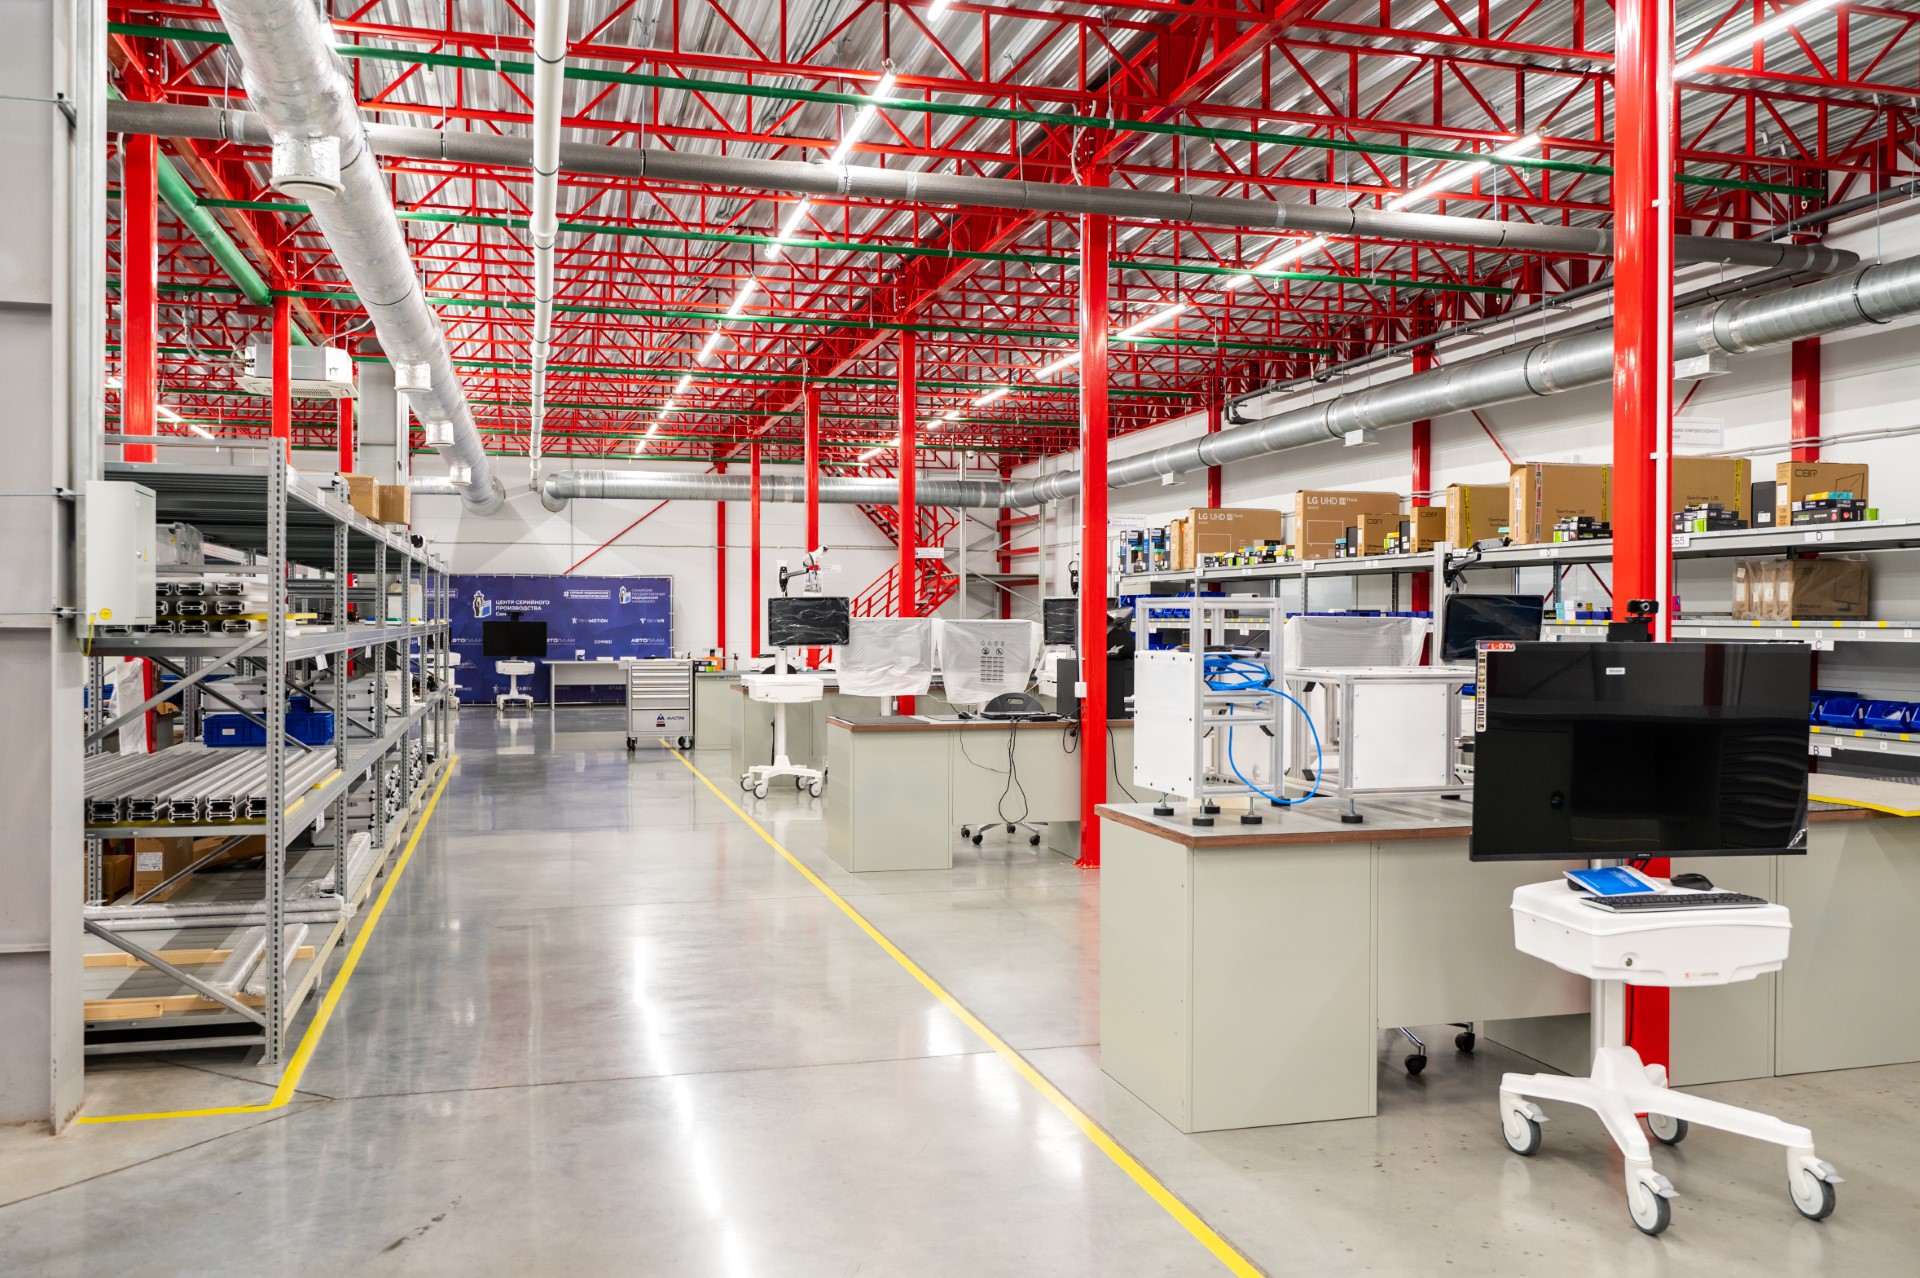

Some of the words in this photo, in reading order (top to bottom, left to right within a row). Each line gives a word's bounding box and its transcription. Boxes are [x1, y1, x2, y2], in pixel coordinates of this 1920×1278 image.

[1794, 468, 1818, 478] CBR
[1306, 496, 1318, 505] LG
[1320, 496, 1338, 505] UHD
[1198, 512, 1209, 520] LG
[1209, 513, 1226, 521] UHD
[1816, 531, 1823, 541] D
